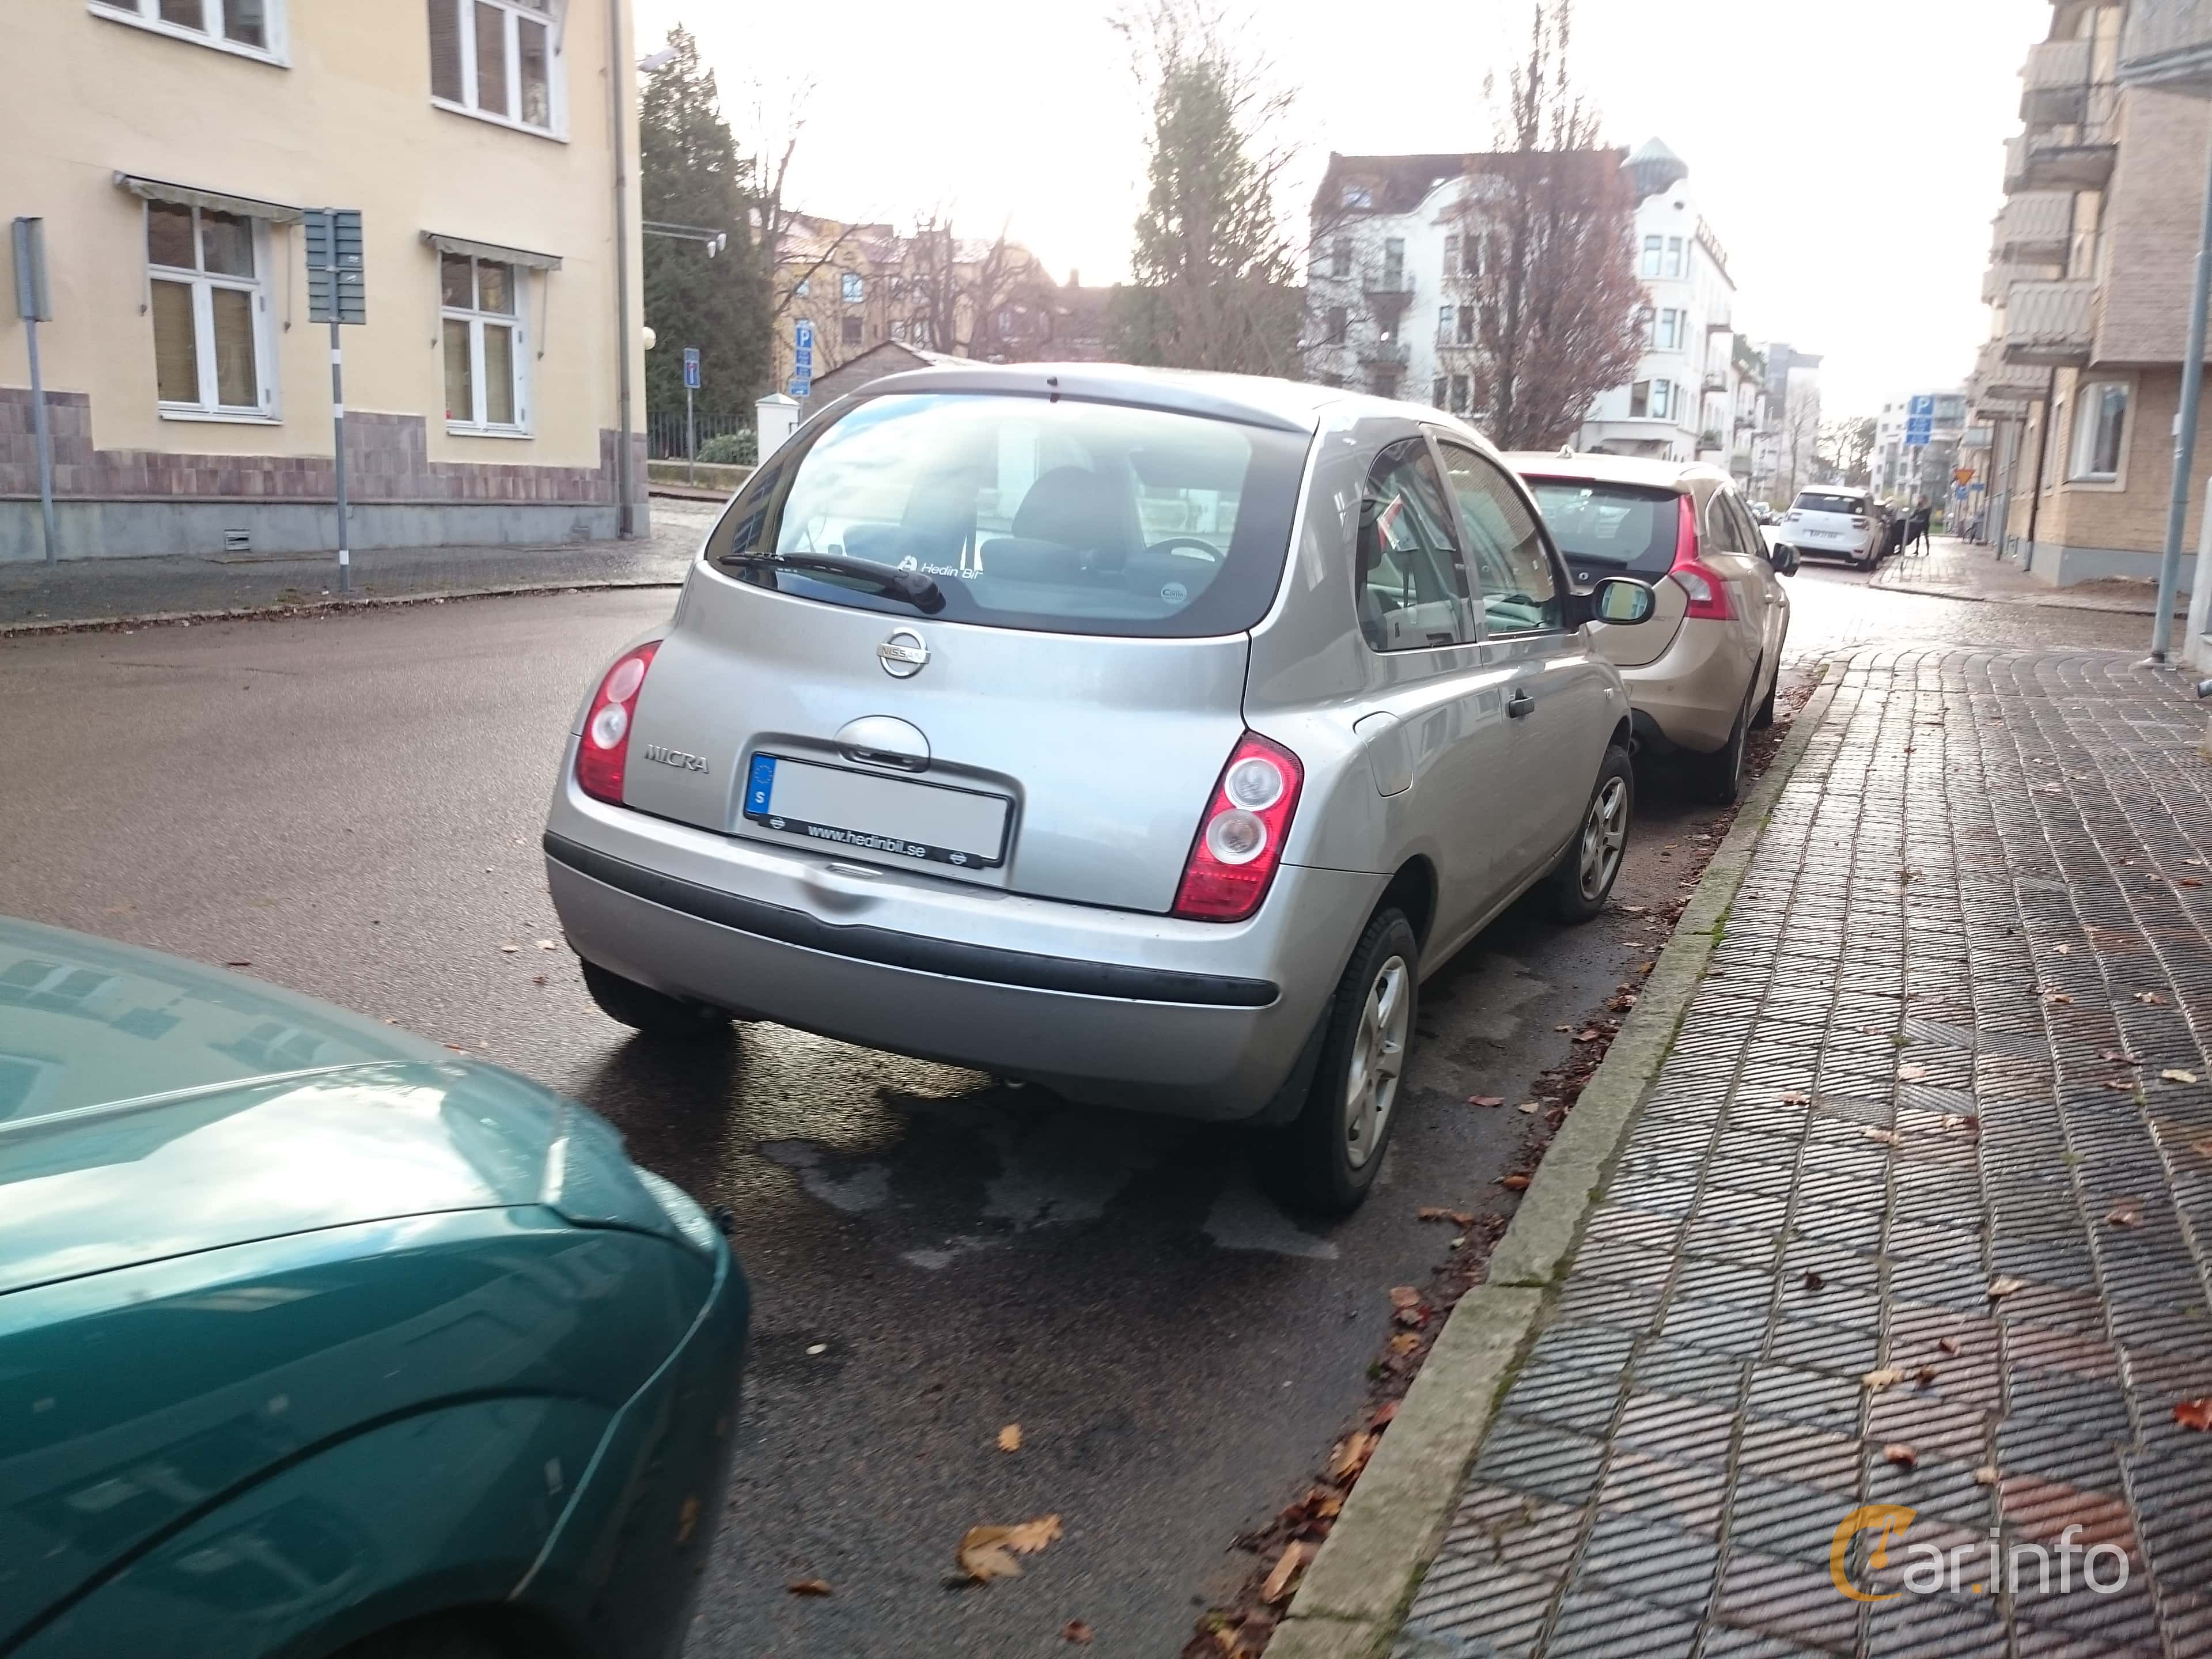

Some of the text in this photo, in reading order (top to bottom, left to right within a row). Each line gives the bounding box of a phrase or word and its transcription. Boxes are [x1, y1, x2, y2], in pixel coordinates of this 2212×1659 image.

[801, 330, 810, 346] P
[1916, 397, 1930, 414] P
[921, 563, 959, 577] Hedin
[881, 646, 922, 661] NISSAN
[645, 744, 709, 774] MICRA
[755, 791, 765, 804] S
[808, 825, 926, 857] www.hedinbil.se
